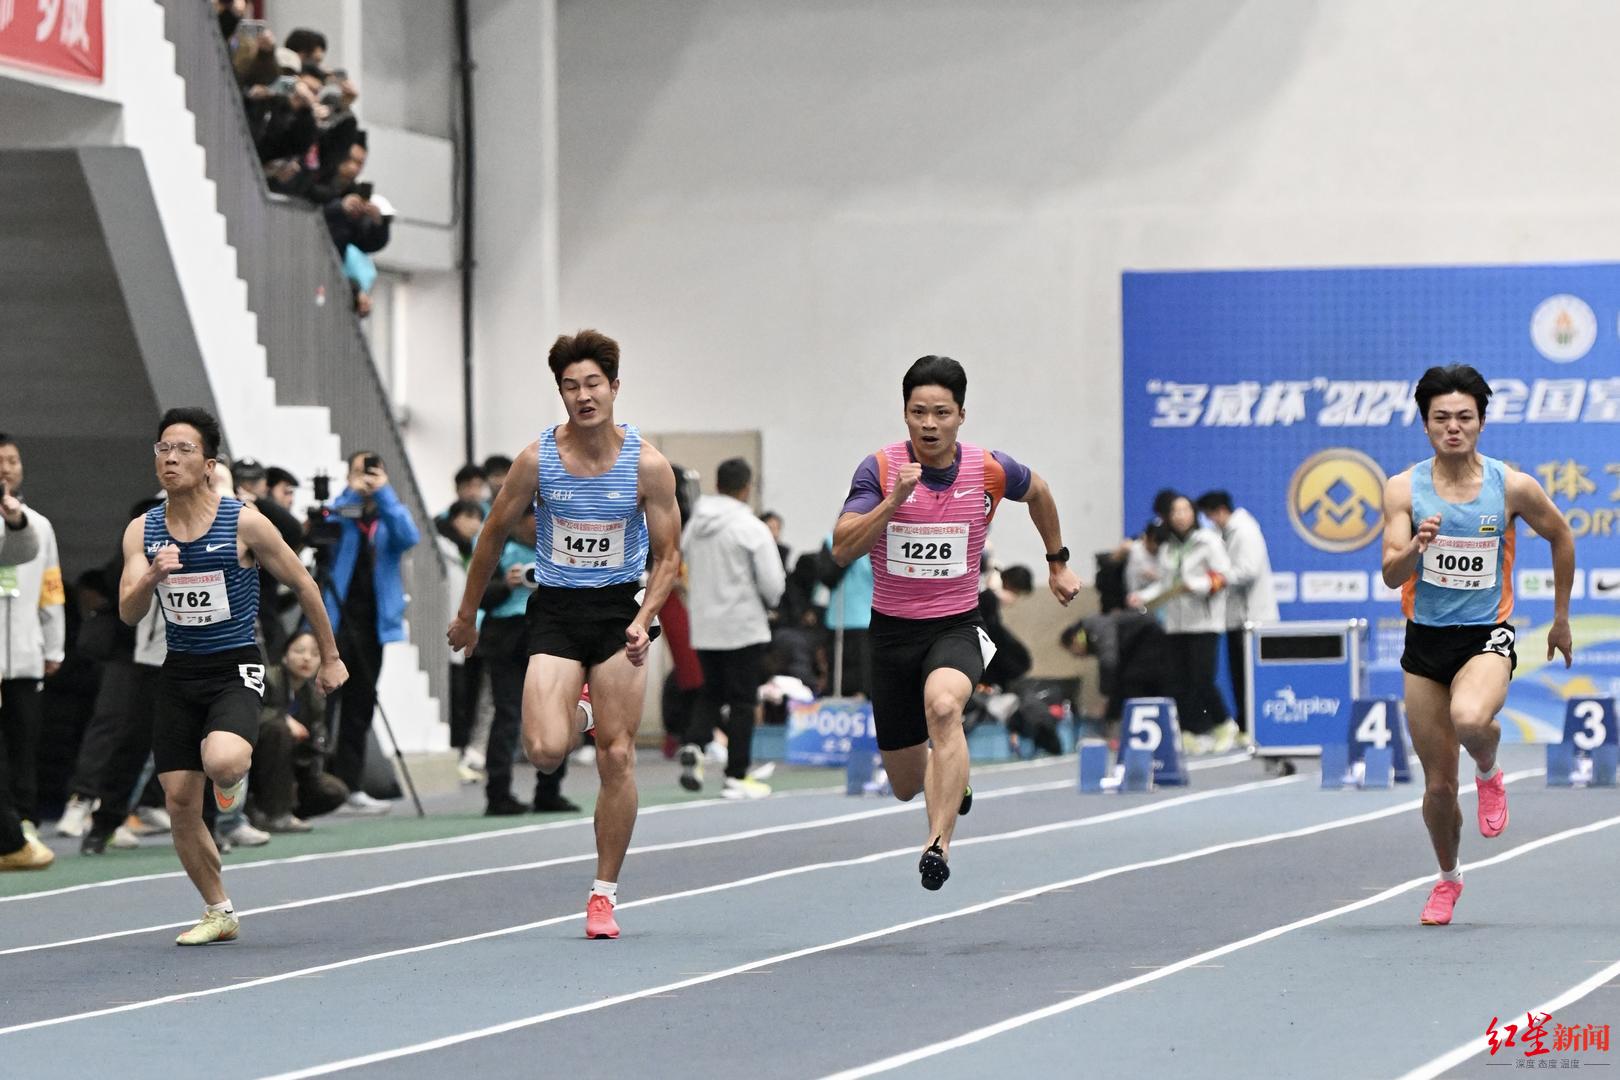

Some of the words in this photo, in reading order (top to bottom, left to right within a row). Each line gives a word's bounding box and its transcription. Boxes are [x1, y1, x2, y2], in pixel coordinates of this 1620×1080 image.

[564, 535, 610, 553] 1479
[901, 542, 952, 560] 1226
[1436, 553, 1484, 572] 1008
[167, 591, 212, 608] 1762
[1128, 705, 1163, 752] 5
[1356, 701, 1392, 749] 4
[1573, 700, 1607, 750] 3
